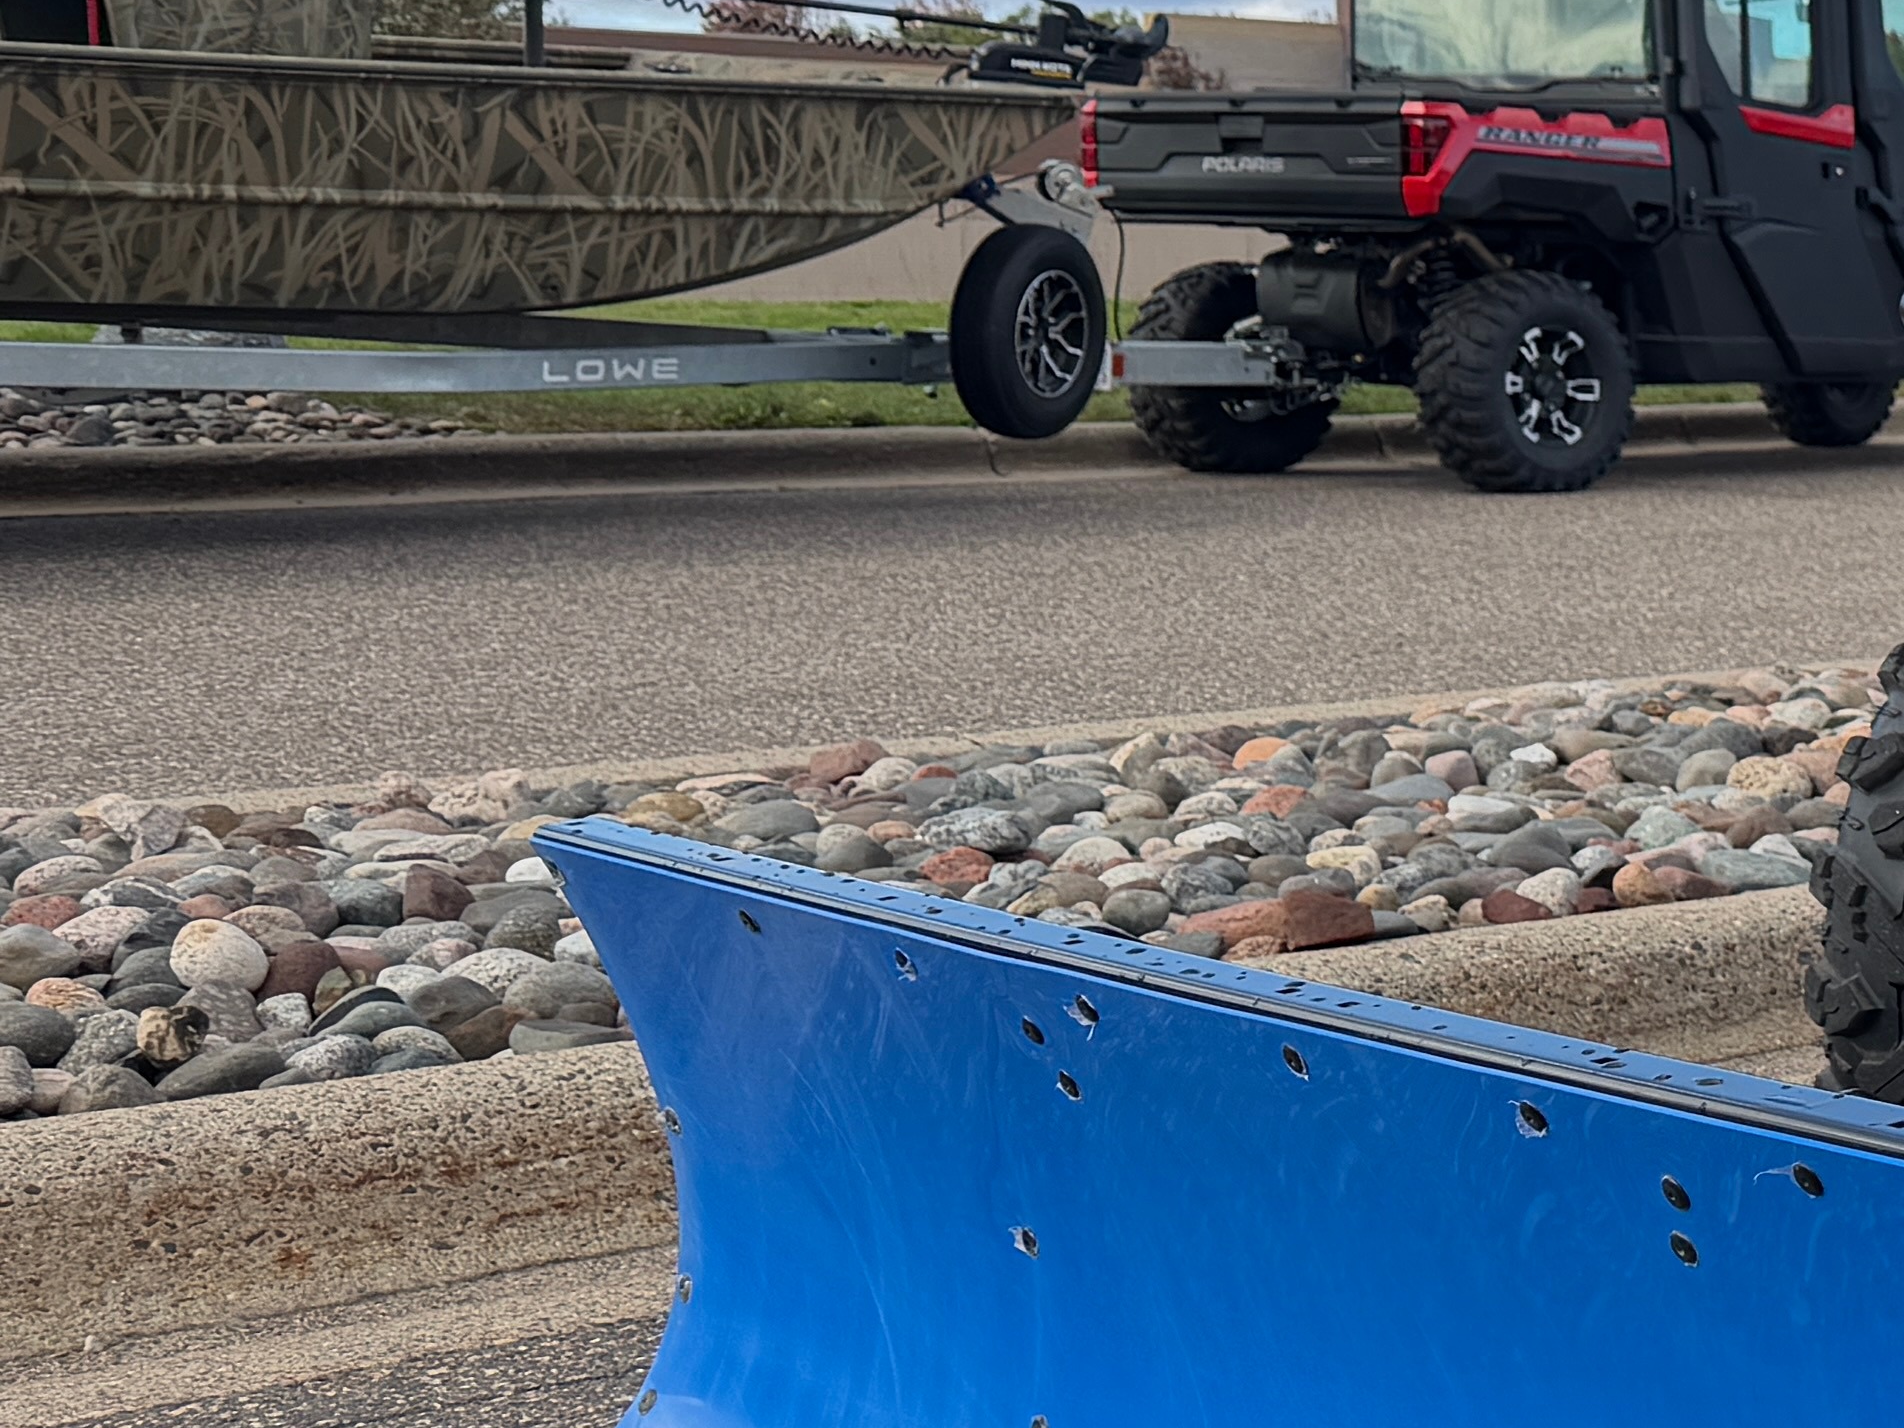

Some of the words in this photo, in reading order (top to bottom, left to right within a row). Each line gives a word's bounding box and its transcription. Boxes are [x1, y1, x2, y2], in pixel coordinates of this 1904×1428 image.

[1478, 125, 1601, 149] RANGER
[1202, 155, 1285, 173] POLARIS
[542, 358, 679, 383] LOWE
